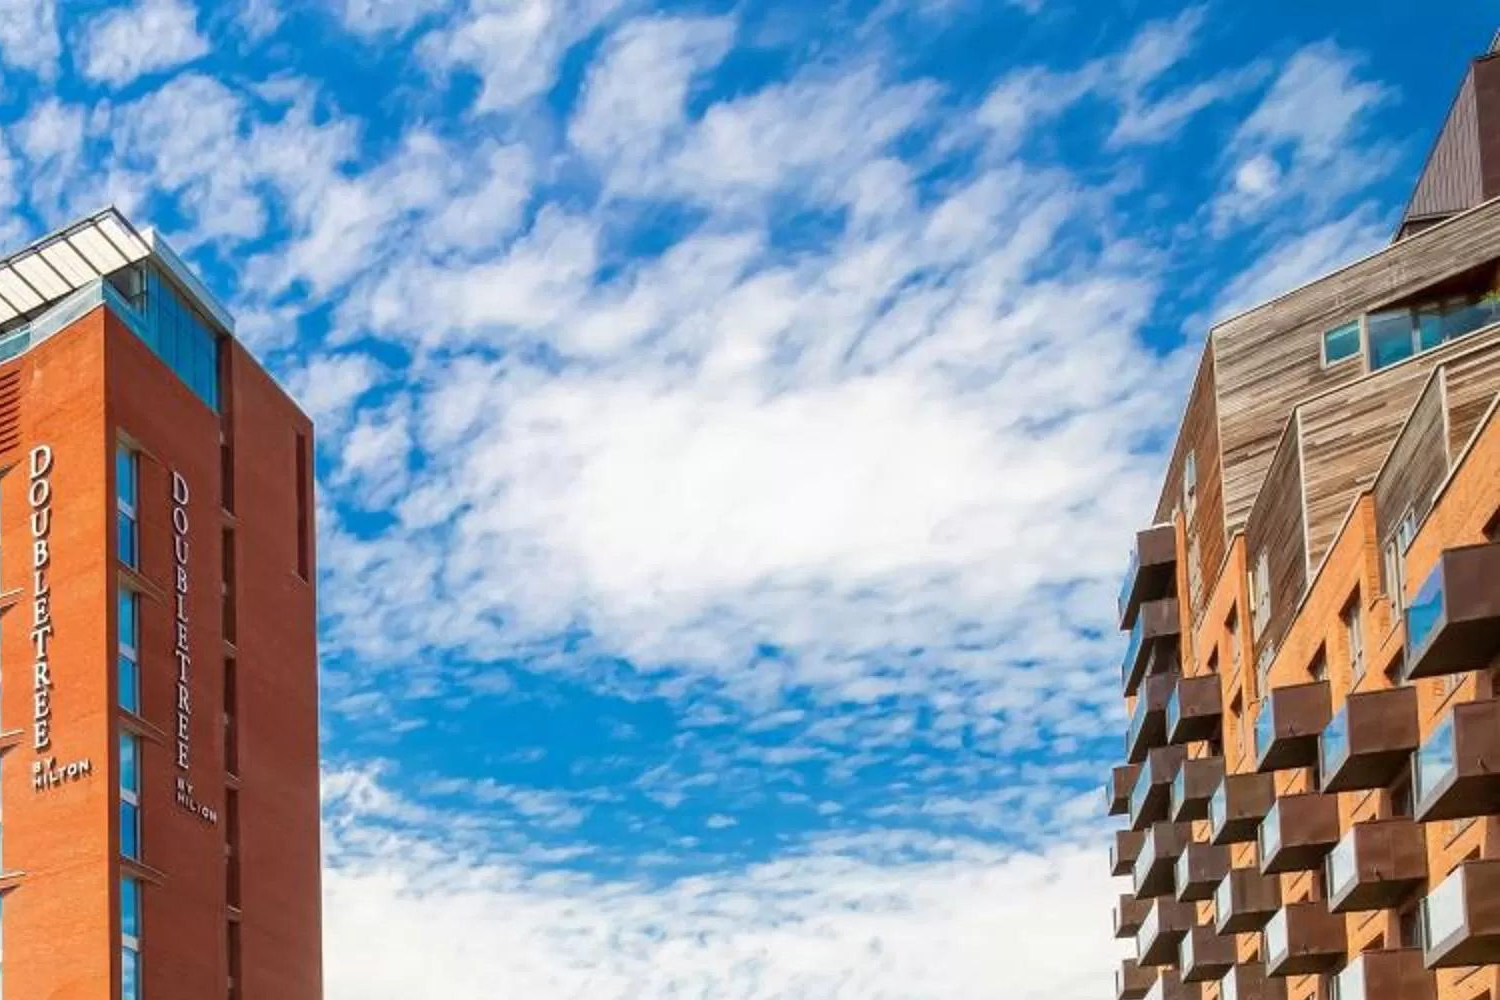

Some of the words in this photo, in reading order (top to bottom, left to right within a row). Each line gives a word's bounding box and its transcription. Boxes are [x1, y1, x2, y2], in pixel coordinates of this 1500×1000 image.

[29, 444, 52, 749] DOUBLETREE
[172, 469, 189, 770] DOUBLETREE
[33, 757, 53, 773] BY
[33, 758, 90, 786] HILTON
[177, 777, 193, 795] BY
[177, 791, 217, 824] HILTON
